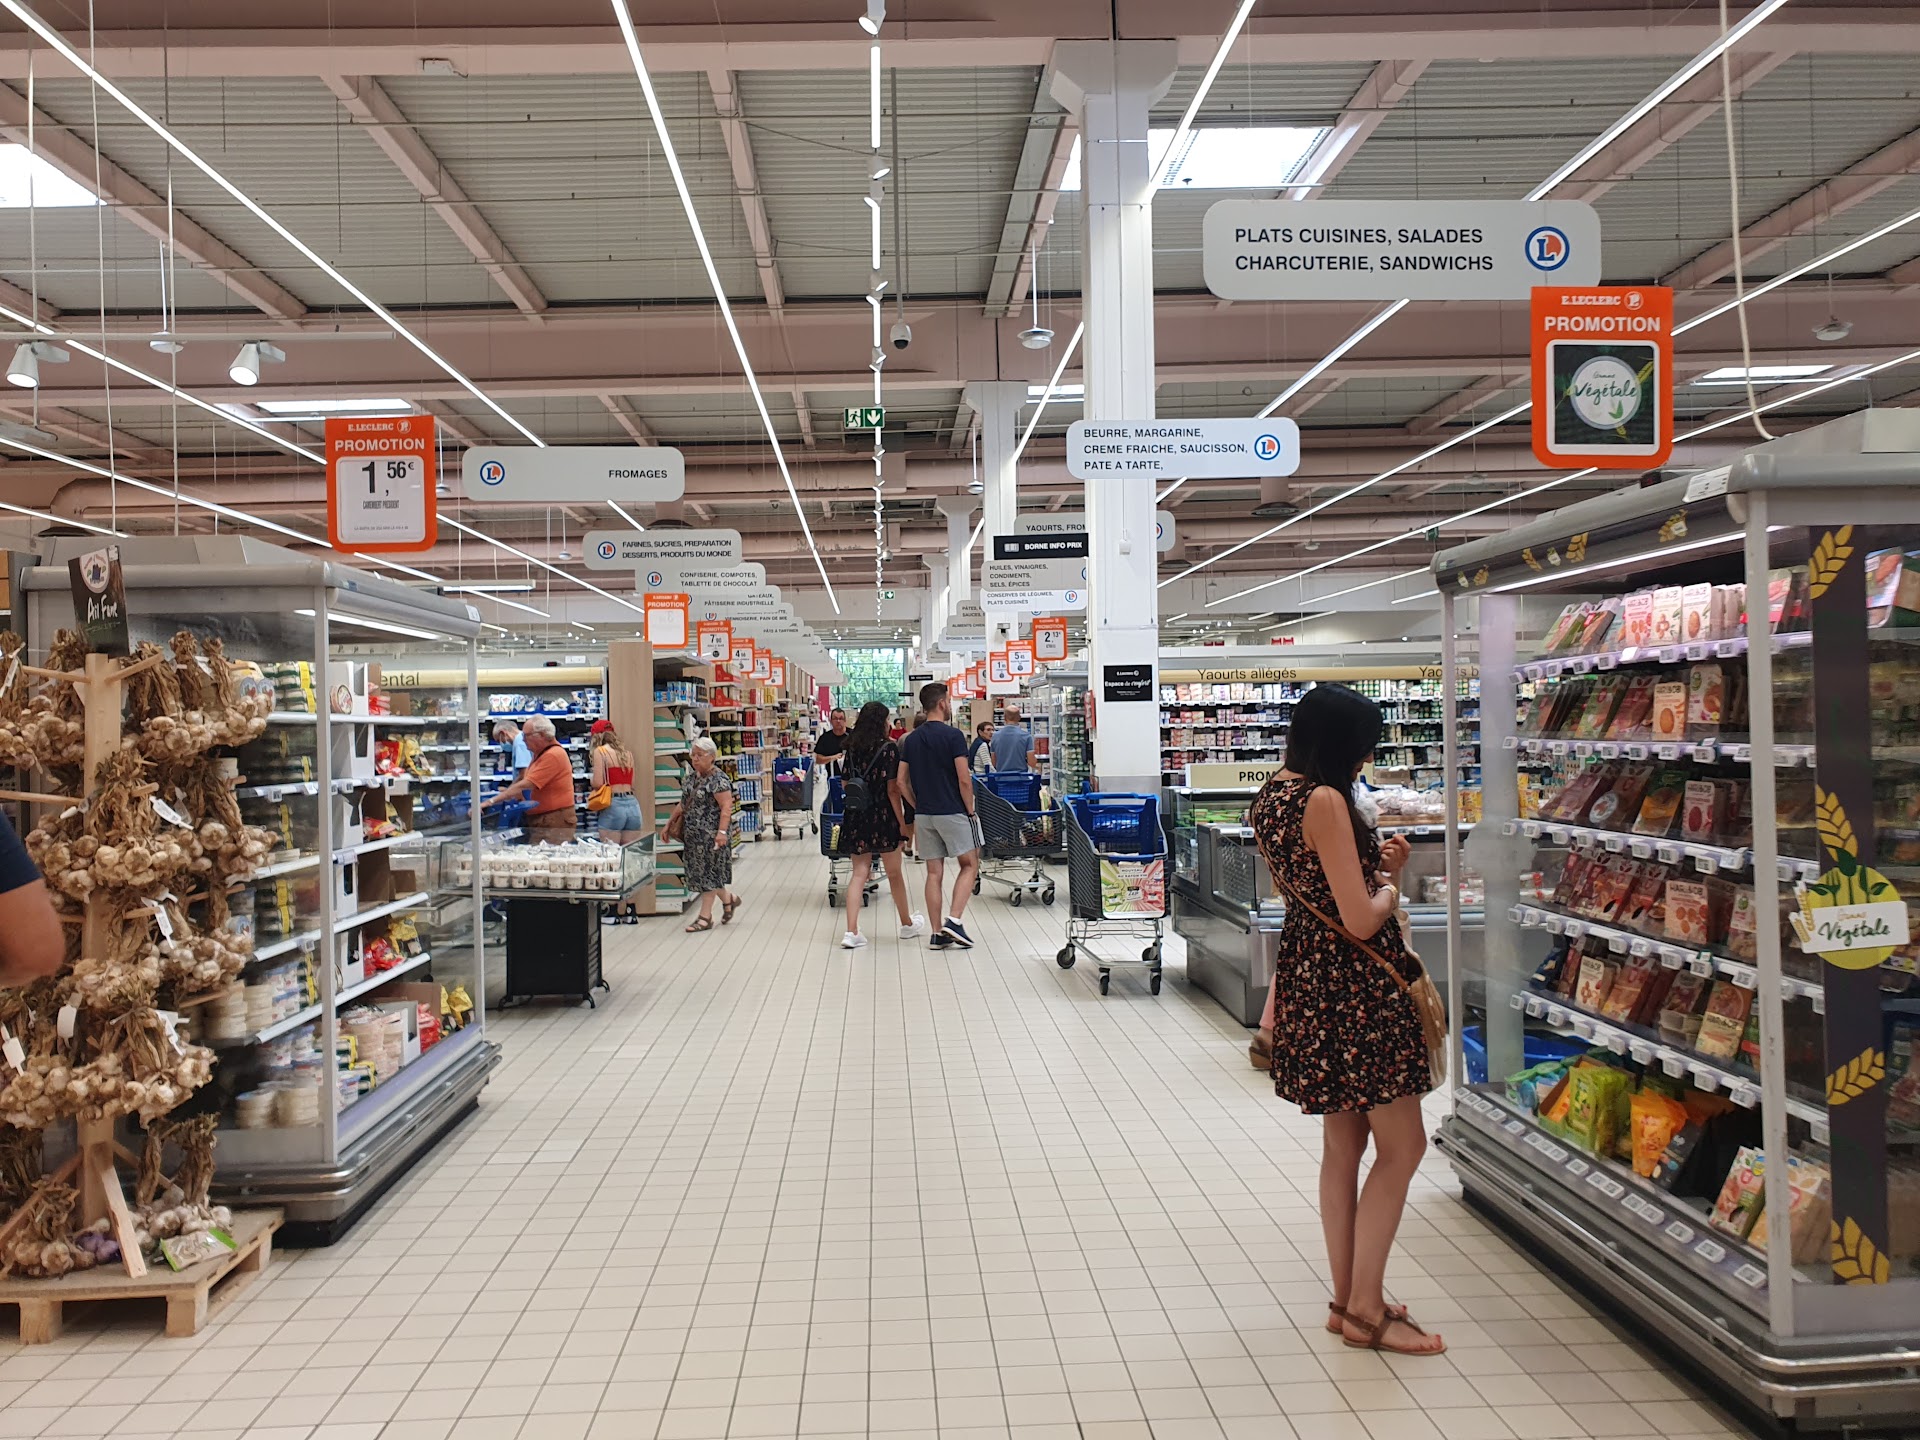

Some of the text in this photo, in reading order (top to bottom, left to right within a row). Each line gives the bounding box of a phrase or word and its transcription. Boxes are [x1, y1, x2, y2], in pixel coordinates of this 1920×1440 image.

[1234, 228, 1483, 246] PLATS CUISINES, SALADES
[1234, 254, 1494, 273] CHARCUTERIE, SANDWICHS
[1544, 316, 1661, 332] PROMOTION
[1573, 379, 1638, 406] Végétale
[348, 423, 394, 432] E.LECLERC
[1083, 427, 1205, 440] BEURRE, MARGARINE,
[334, 437, 425, 452] PROMOTION
[1083, 442, 1249, 456] CREME FRAICHE, SAUCISSON,
[1083, 460, 1164, 472] PATE A TARTE,
[608, 469, 668, 479] FROMAGES
[1025, 524, 1066, 533] YAOURTS,
[622, 539, 732, 549] FARINES, SUCRES, PREPARATION
[1024, 541, 1083, 551] BORNE INFO PRIX
[622, 550, 732, 559] DESSERTS, PRODUITS DU MONDE
[679, 571, 758, 579] CONFISERIE, COMPOTES,
[680, 580, 712, 588] TABLETTE
[1008, 580, 1031, 588] ÉPICES
[647, 601, 685, 609] PROMOTION
[1197, 667, 1298, 681] Yaourts allégés
